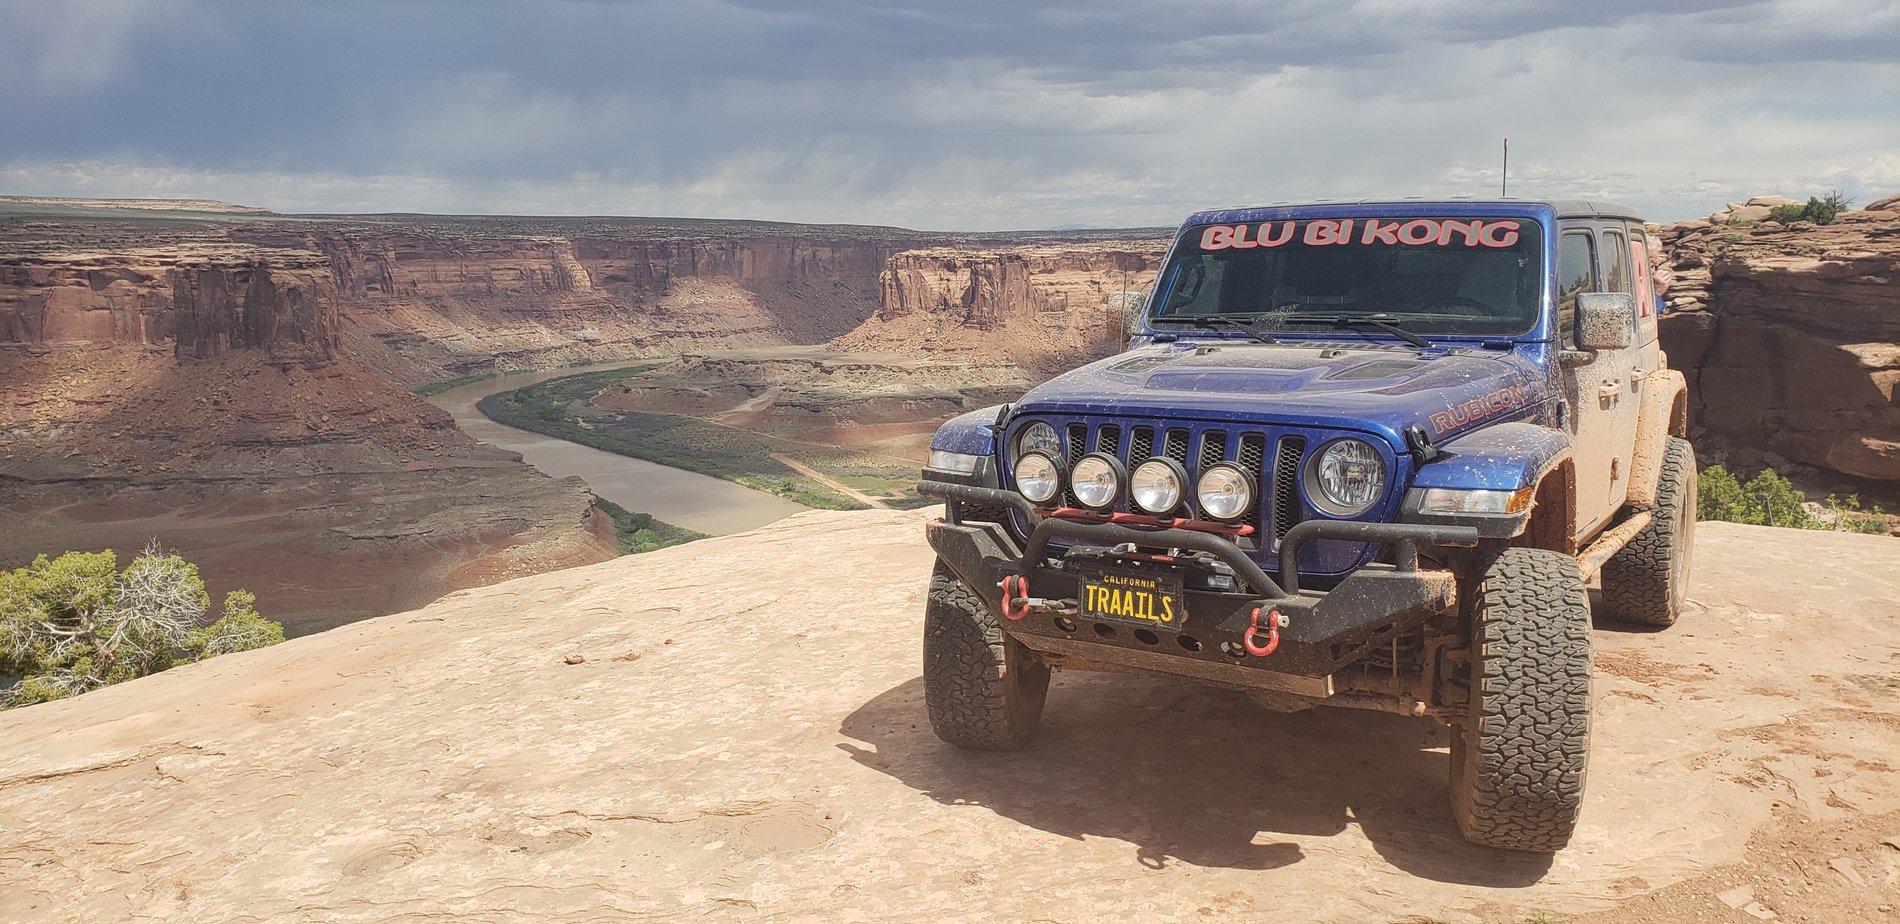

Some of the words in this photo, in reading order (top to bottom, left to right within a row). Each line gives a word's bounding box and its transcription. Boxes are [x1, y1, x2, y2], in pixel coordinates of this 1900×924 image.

[1200, 221, 1296, 250] BLU
[1303, 219, 1354, 246] BI
[1360, 219, 1520, 248] KONG
[1429, 385, 1526, 434] RUBICON
[1104, 575, 1155, 588] CALIFORNIA
[1086, 585, 1173, 622] TRAAILS
